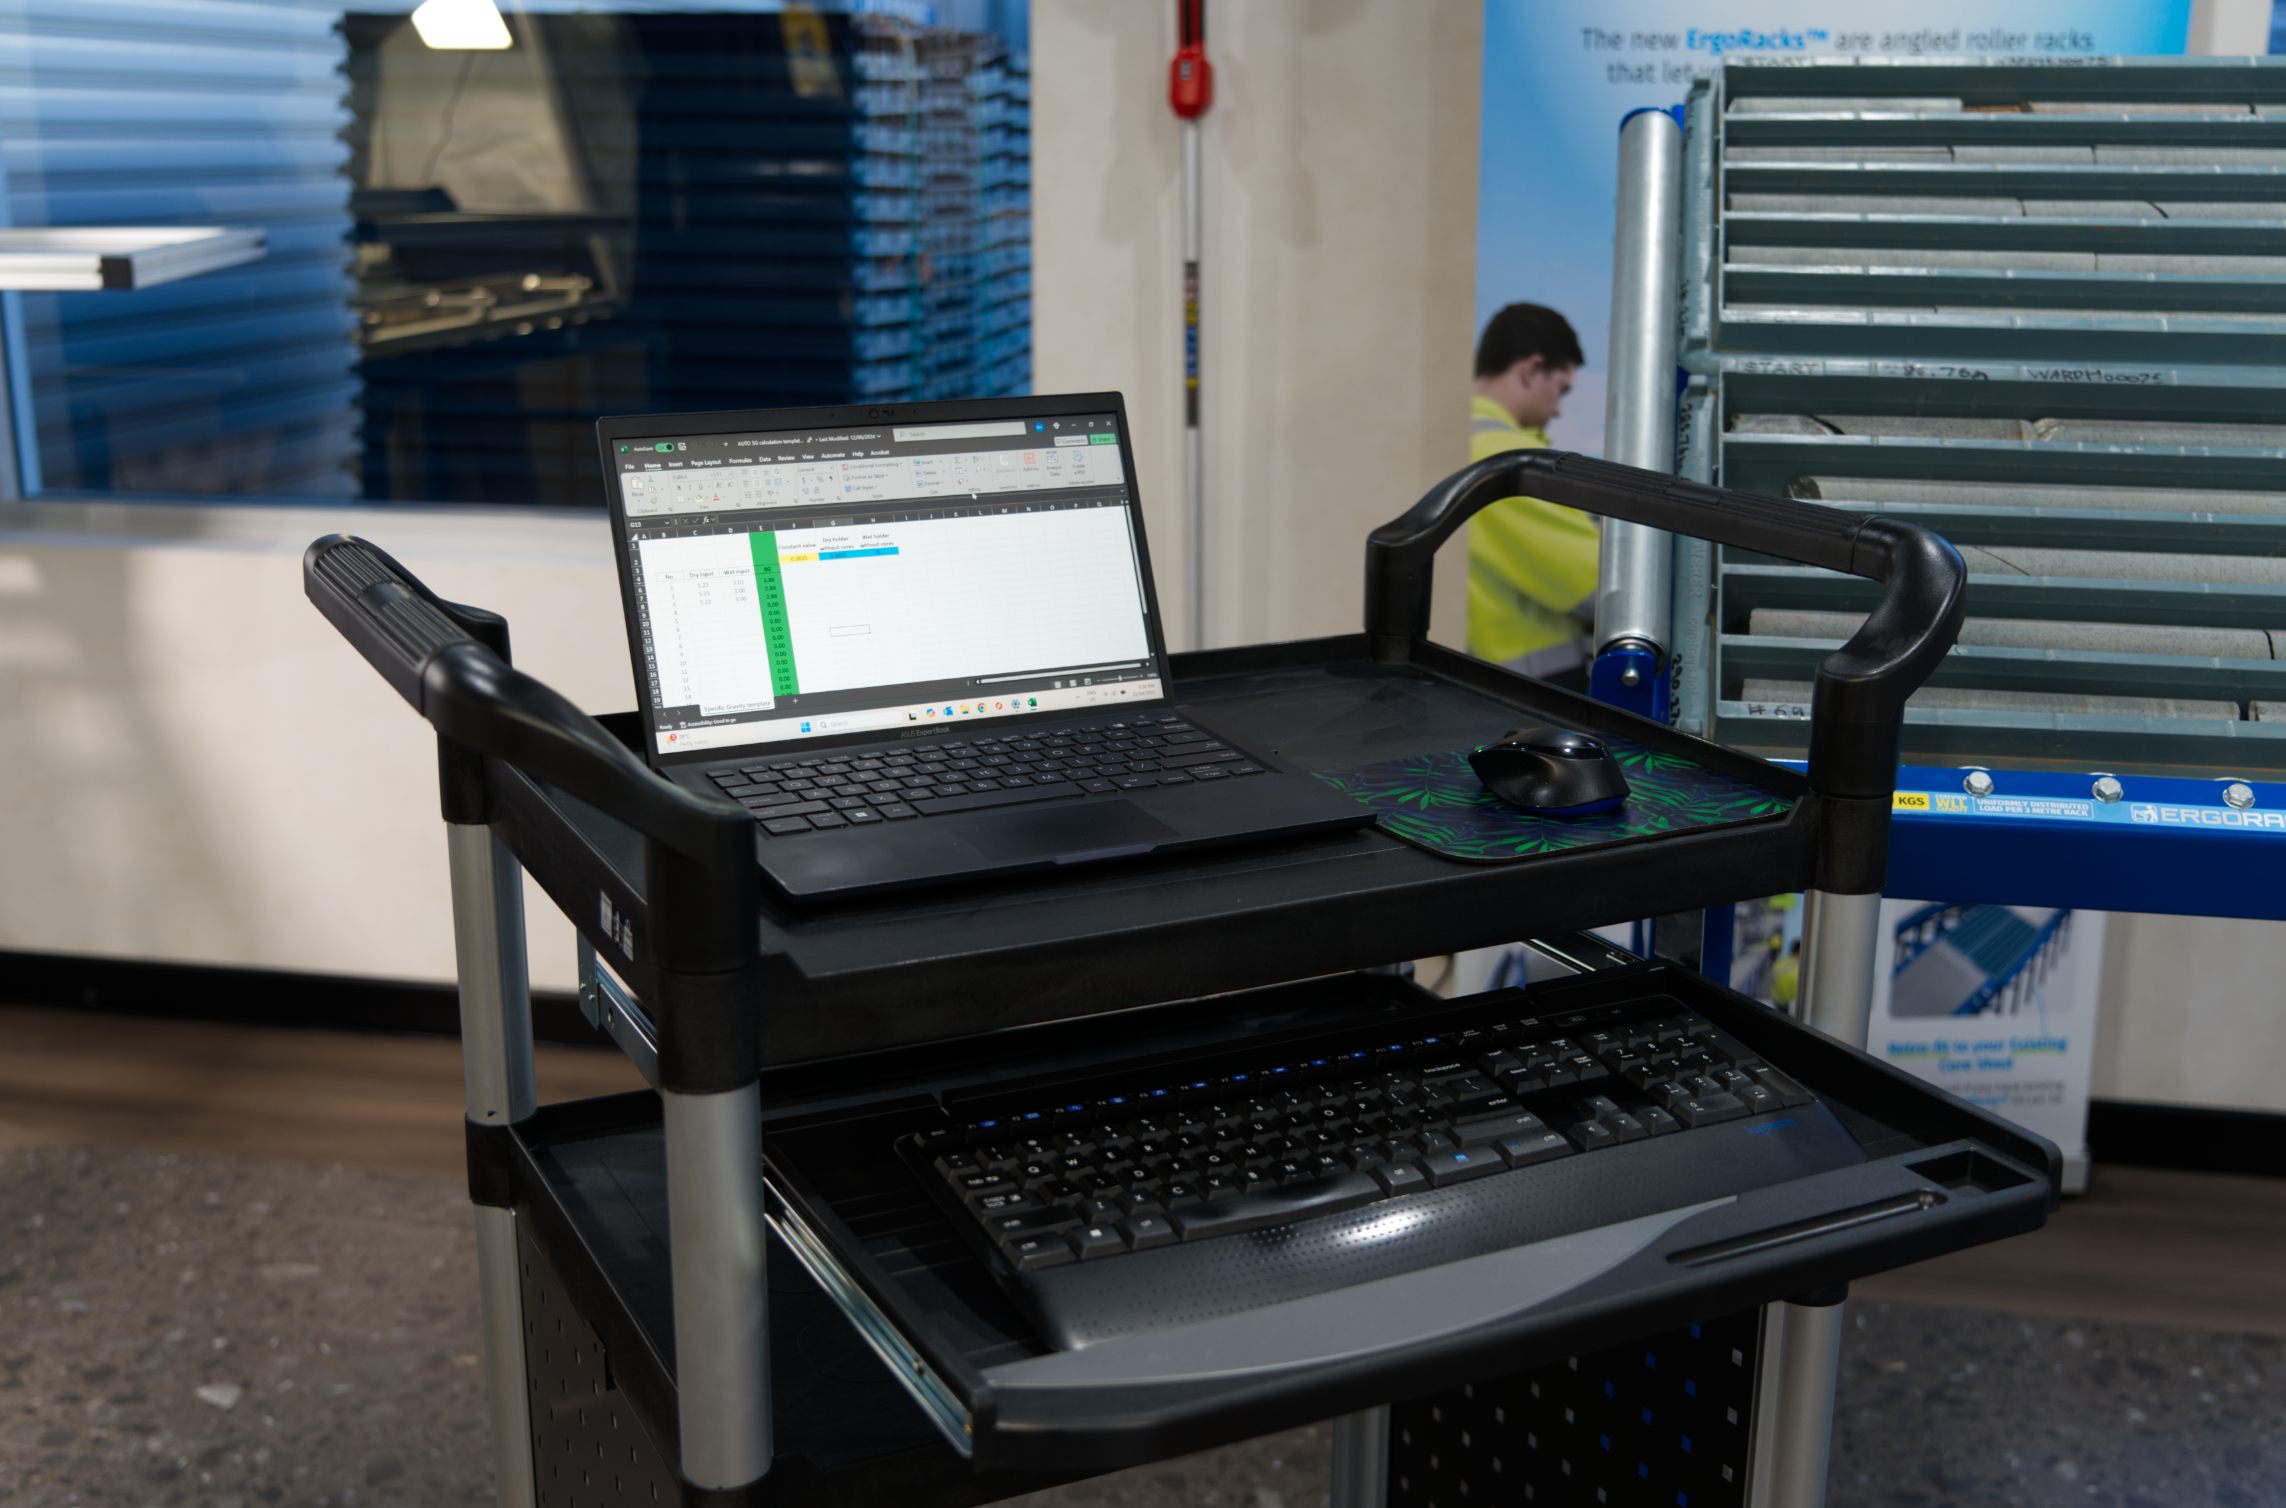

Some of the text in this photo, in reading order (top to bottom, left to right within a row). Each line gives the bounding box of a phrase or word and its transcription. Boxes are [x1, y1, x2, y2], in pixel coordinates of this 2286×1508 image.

[1582, 28, 1623, 49] The
[1631, 33, 1677, 49] new
[1836, 32, 1873, 50] are
[1880, 28, 1959, 55] angled
[1966, 28, 2028, 50] roller
[2035, 28, 2095, 50] racks
[1607, 63, 1657, 84] that
[1662, 62, 1692, 83] let
[1744, 361, 1818, 375] START
[704, 700, 771, 713] Specific Gravity template
[901, 726, 950, 738] ASUS ExpertBook
[1899, 797, 1924, 805] KGS
[1936, 799, 1968, 809] WLL
[1977, 799, 2089, 810] UNIFORMLY DISTRIBUTED
[2160, 808, 2286, 828] ERGORA
[1423, 1062, 1461, 1073] backspace
[1488, 1098, 1508, 1106] enter
[1516, 1116, 1531, 1124] shift
[1743, 1118, 1796, 1135] logitech
[1002, 1219, 1022, 1228] shift
[1020, 1241, 1038, 1249] ctrl
